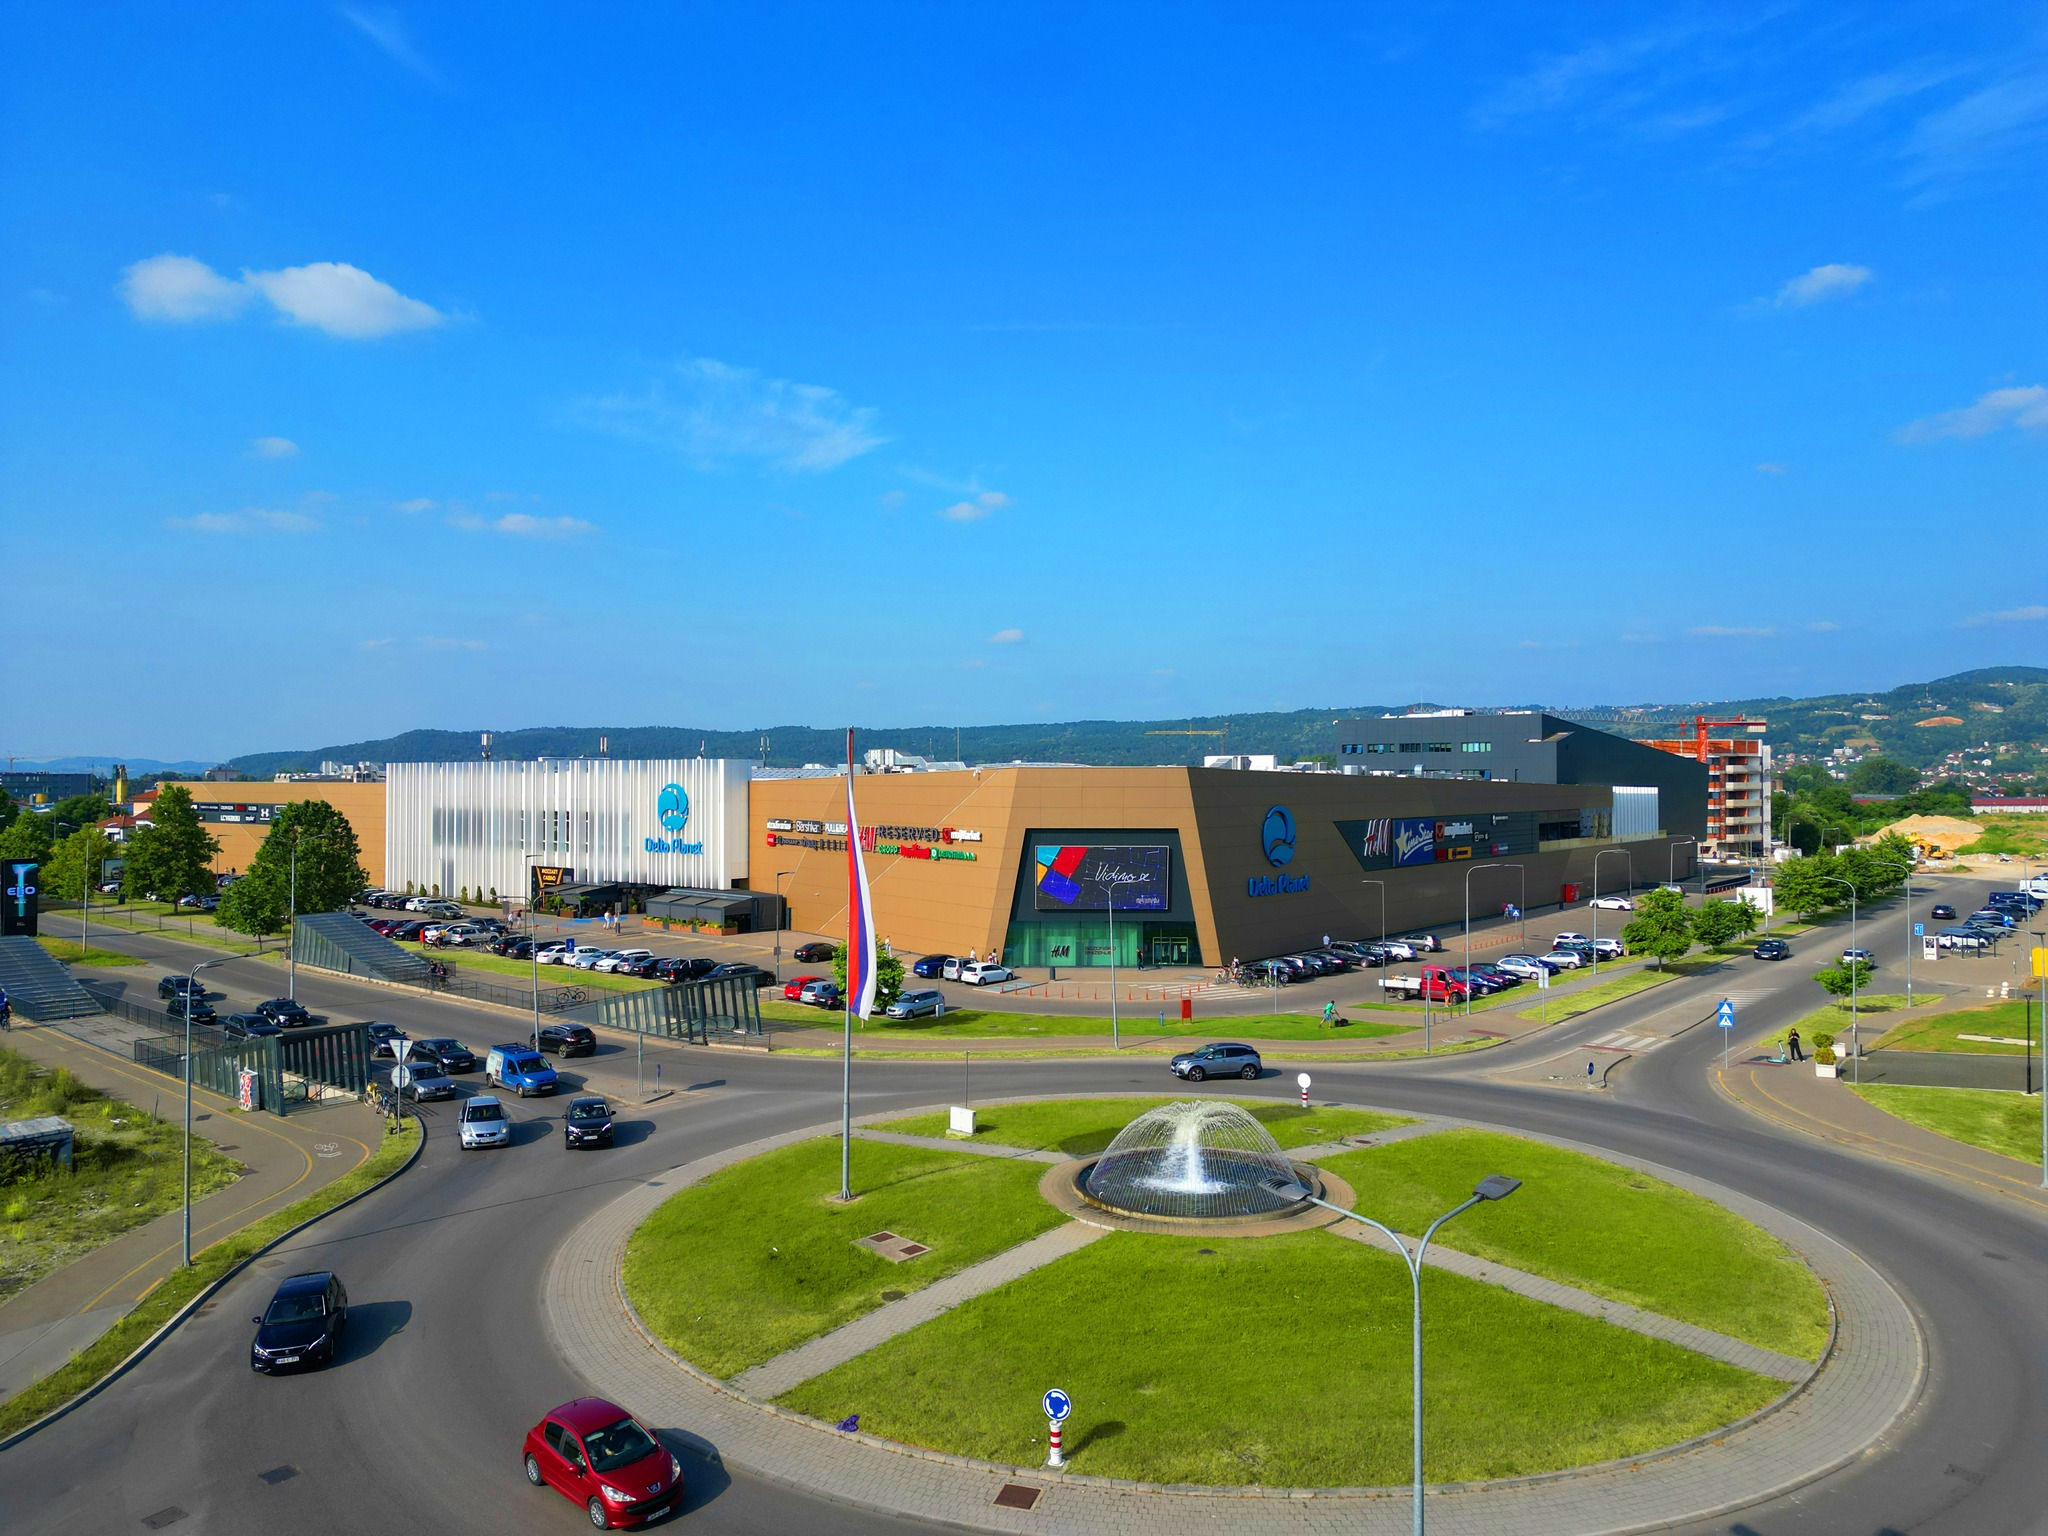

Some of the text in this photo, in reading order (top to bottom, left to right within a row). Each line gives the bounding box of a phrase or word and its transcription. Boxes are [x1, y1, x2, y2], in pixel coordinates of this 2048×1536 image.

[796, 821, 819, 833] Bershka
[825, 823, 848, 834] PULL&BEA
[879, 825, 939, 841] RESERVED
[645, 837, 703, 855] Delta Planet
[1364, 819, 1390, 857] H&M
[1248, 873, 1309, 897] Delta Planet
[1051, 945, 1070, 958] H&M
